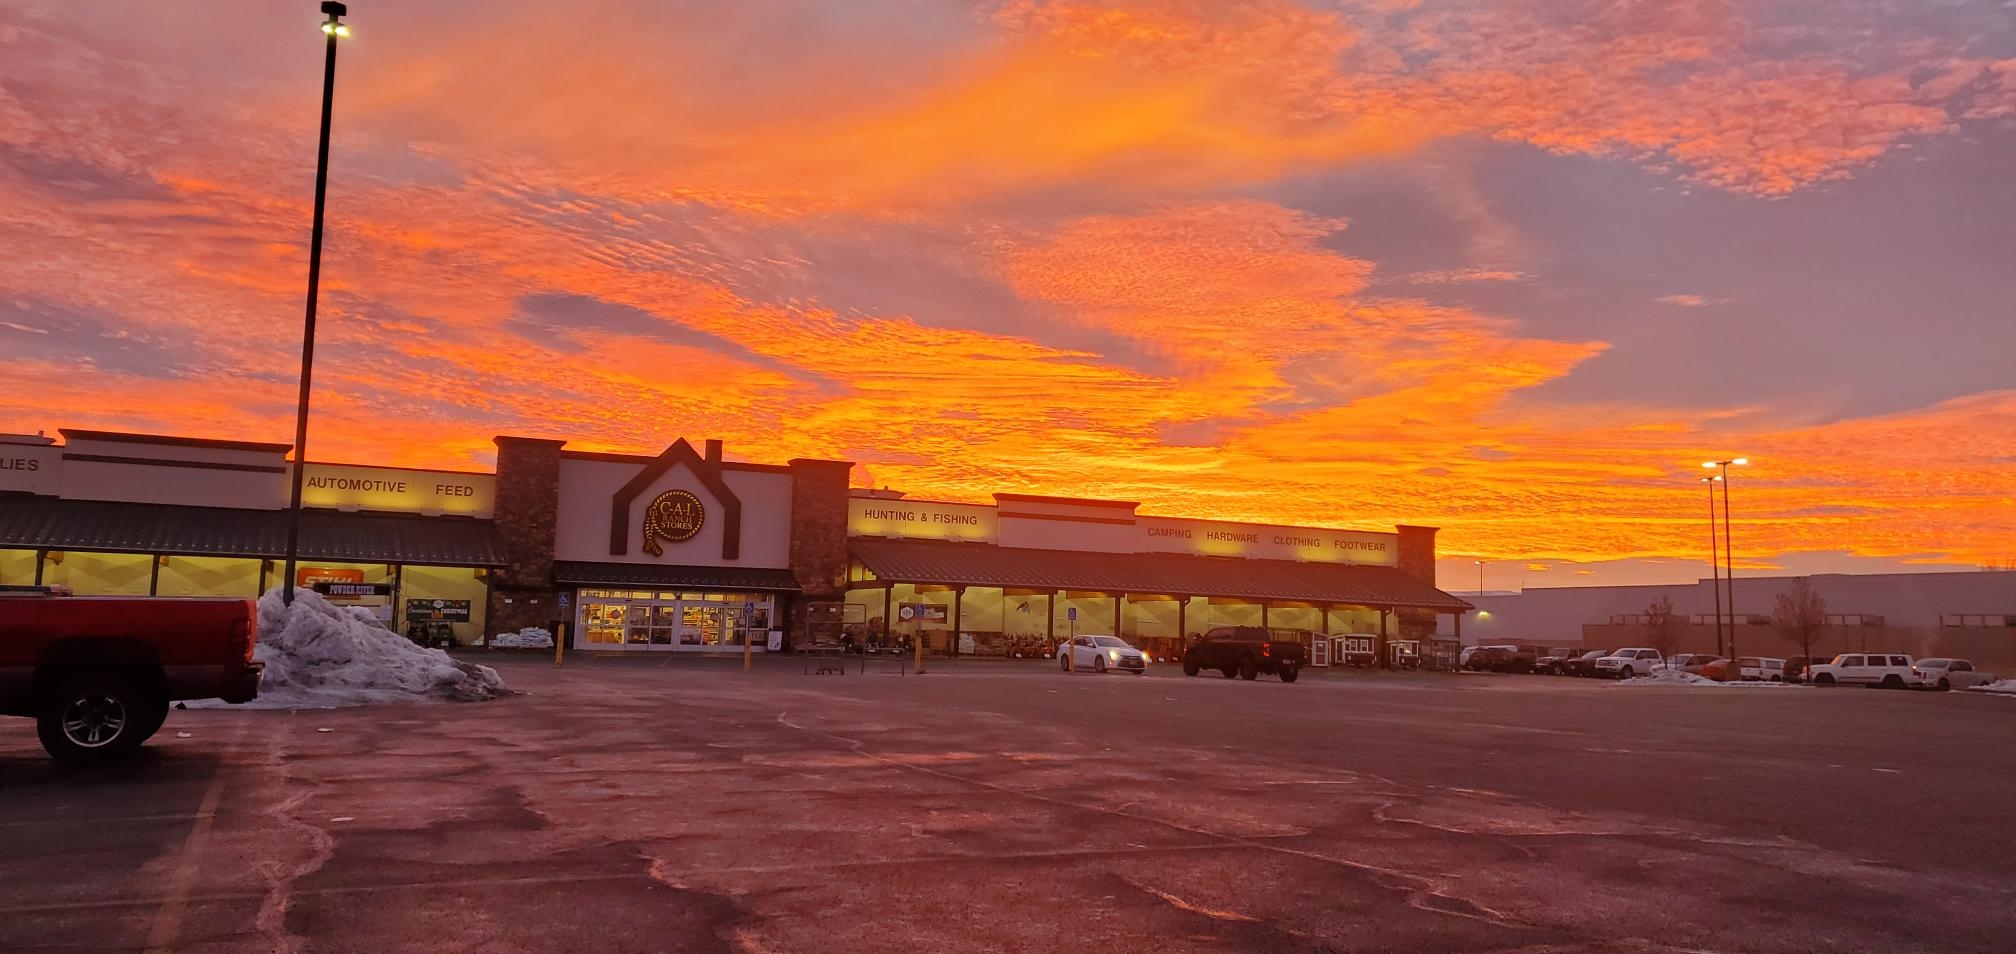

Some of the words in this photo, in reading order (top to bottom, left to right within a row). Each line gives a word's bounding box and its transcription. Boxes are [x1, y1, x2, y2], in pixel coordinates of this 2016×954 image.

[307, 476, 406, 493] AUTOMOTIVE
[435, 484, 474, 497] FEED
[662, 515, 692, 523] RANCH
[864, 509, 915, 521] HUNTING
[920, 513, 928, 522] &
[933, 513, 978, 525] FISHING
[661, 521, 693, 530] STORES
[1147, 527, 1192, 539] CAMPING
[1206, 531, 1260, 544] HARDWARE
[1273, 535, 1321, 548] CLOTHING
[1334, 540, 1386, 552] FOOTWEAR
[329, 585, 355, 594] POWDER
[356, 585, 375, 594] RIVER
